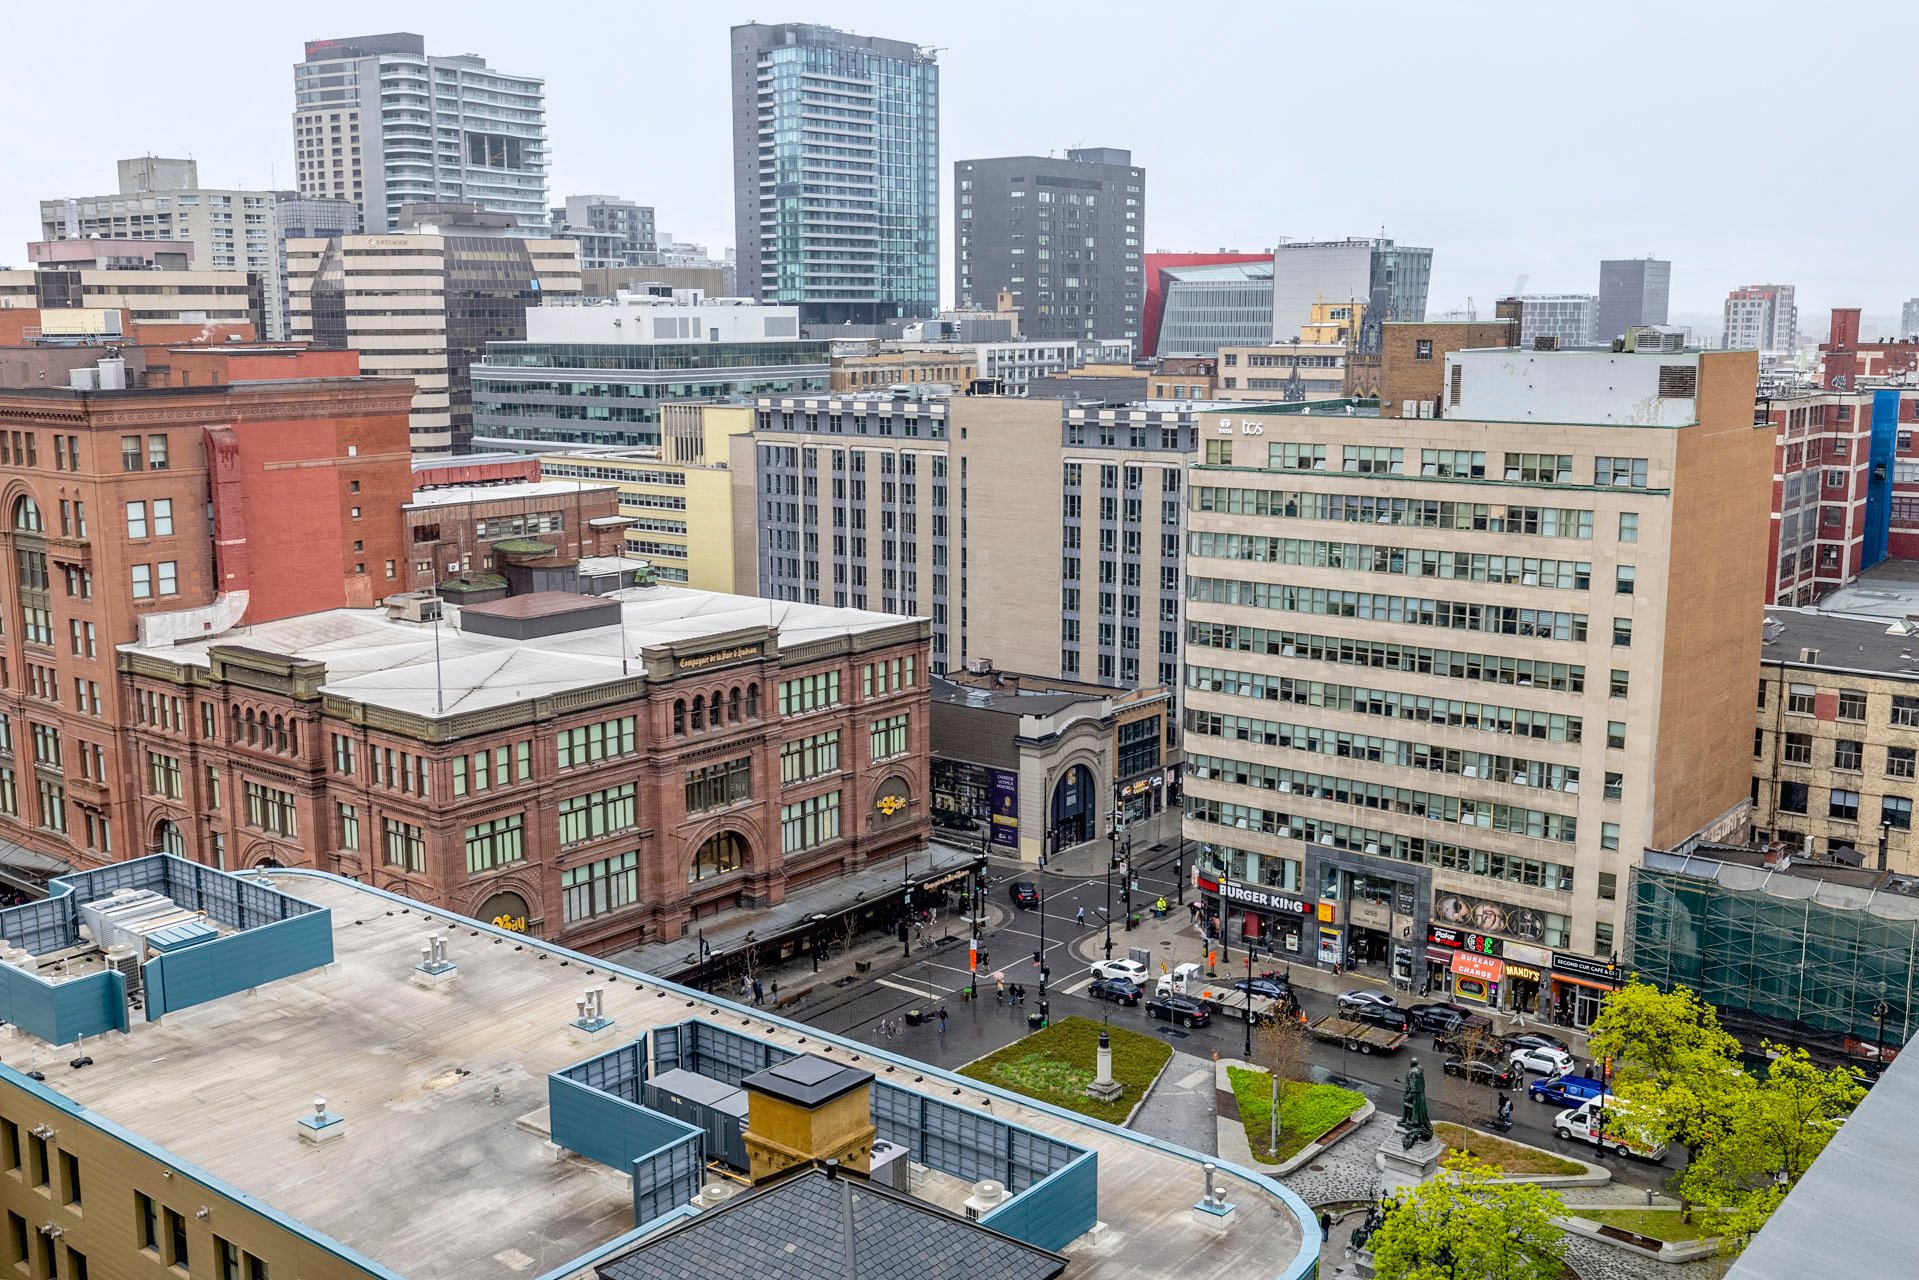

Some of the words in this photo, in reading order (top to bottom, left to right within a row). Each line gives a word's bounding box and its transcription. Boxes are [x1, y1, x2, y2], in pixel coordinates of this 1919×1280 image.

[1242, 419, 1264, 435] tcs
[1219, 884, 1268, 905] BURGER
[1270, 895, 1303, 913] KING
[1435, 930, 1455, 941] Poke
[1460, 953, 1495, 967] BUREAU
[1557, 959, 1578, 968] SECOND
[1458, 966, 1492, 979] CHANGE
[1505, 966, 1540, 982] MANDY'S
